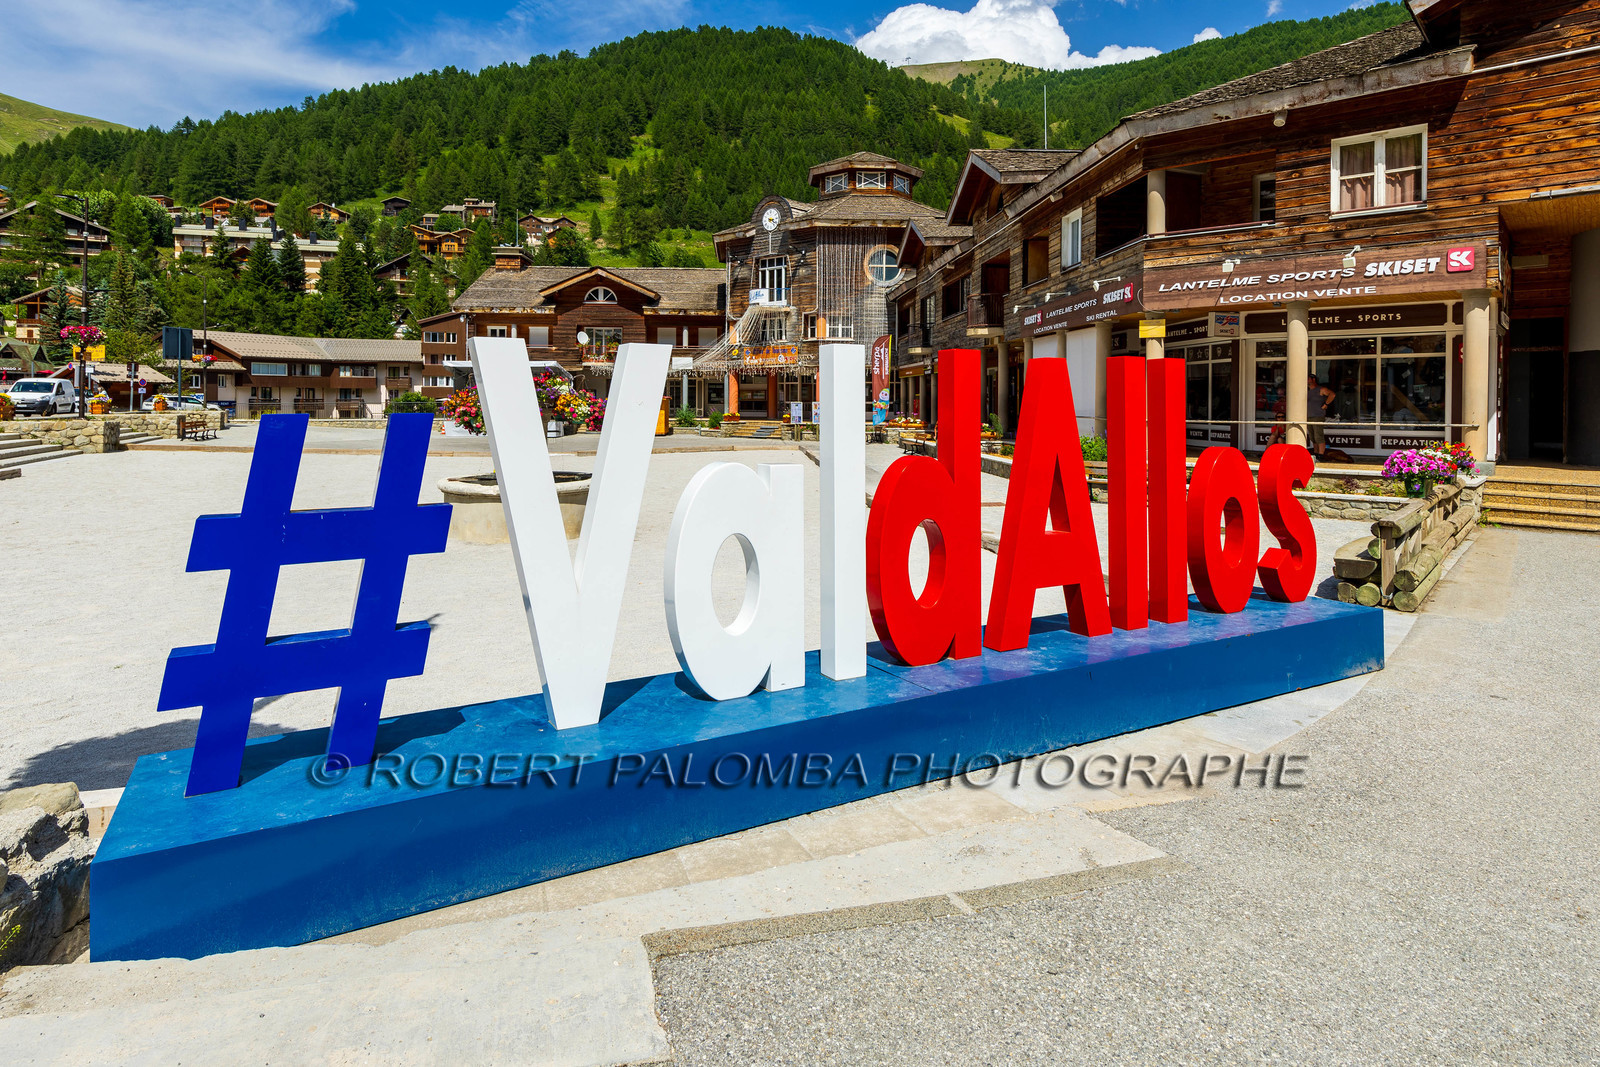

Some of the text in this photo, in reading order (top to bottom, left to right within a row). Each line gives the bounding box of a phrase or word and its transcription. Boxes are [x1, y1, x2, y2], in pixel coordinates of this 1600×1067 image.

[1159, 275, 1261, 292] LANTELME
[1266, 267, 1356, 284] SPORTS
[1364, 257, 1441, 278] SKISET
[1219, 285, 1377, 304] LOCATION VENTE
[1024, 313, 1038, 326] SKISET
[1046, 305, 1073, 319] LANTELME
[1073, 298, 1098, 312] SPORTS
[1102, 288, 1125, 305] SKISET
[1086, 309, 1118, 322] SKI RENTAL
[1358, 312, 1402, 323] SPORTS
[1033, 321, 1068, 335] LOCATION VENTE
[1193, 325, 1209, 334] SPORT
[872, 346, 880, 375] sherpa
[1328, 437, 1361, 445] VENTE
